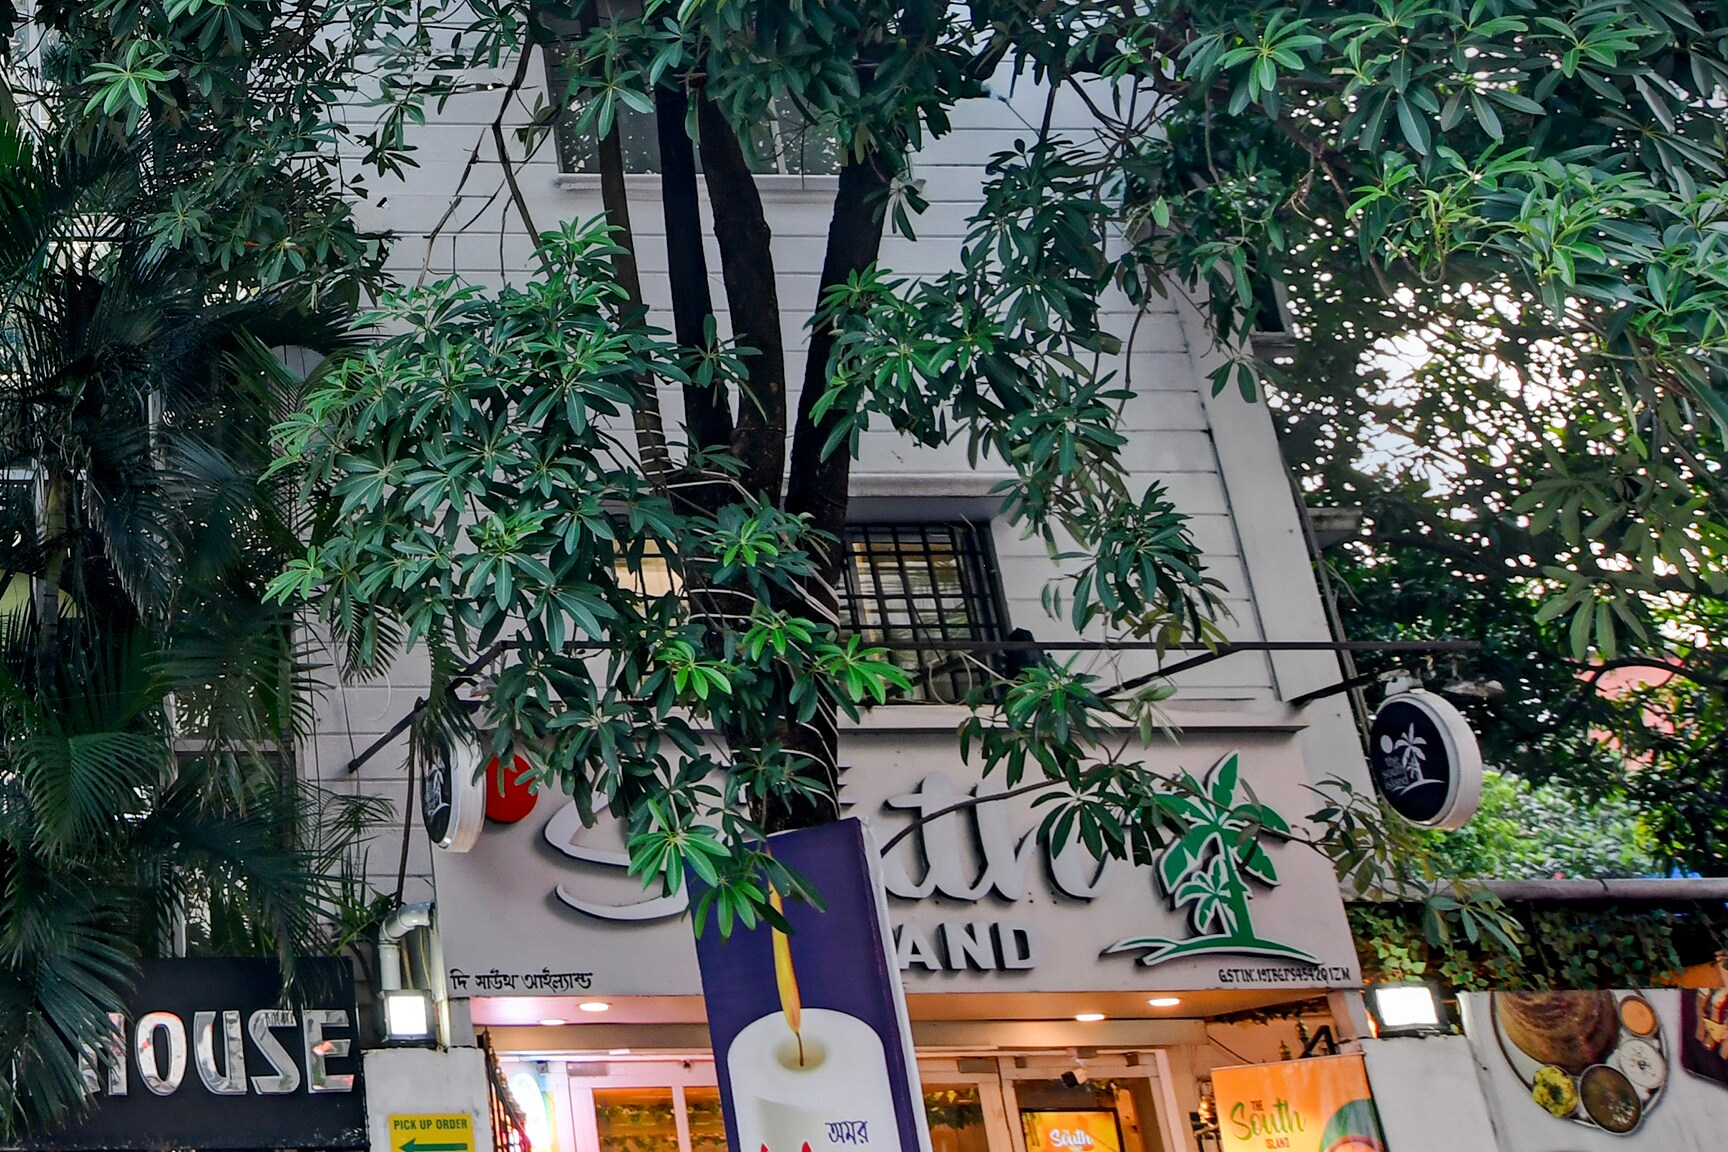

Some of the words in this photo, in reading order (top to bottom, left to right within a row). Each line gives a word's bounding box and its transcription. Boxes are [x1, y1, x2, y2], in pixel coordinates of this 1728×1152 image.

[450, 969, 470, 990] দি
[475, 968, 518, 990] সাউথ
[393, 1119, 417, 1130] PICK
[419, 1119, 433, 1130] UP
[436, 1118, 468, 1129] ORDER
[1230, 1098, 1305, 1140] South
[825, 1120, 869, 1144] অমর
[1049, 1129, 1093, 1147] South
